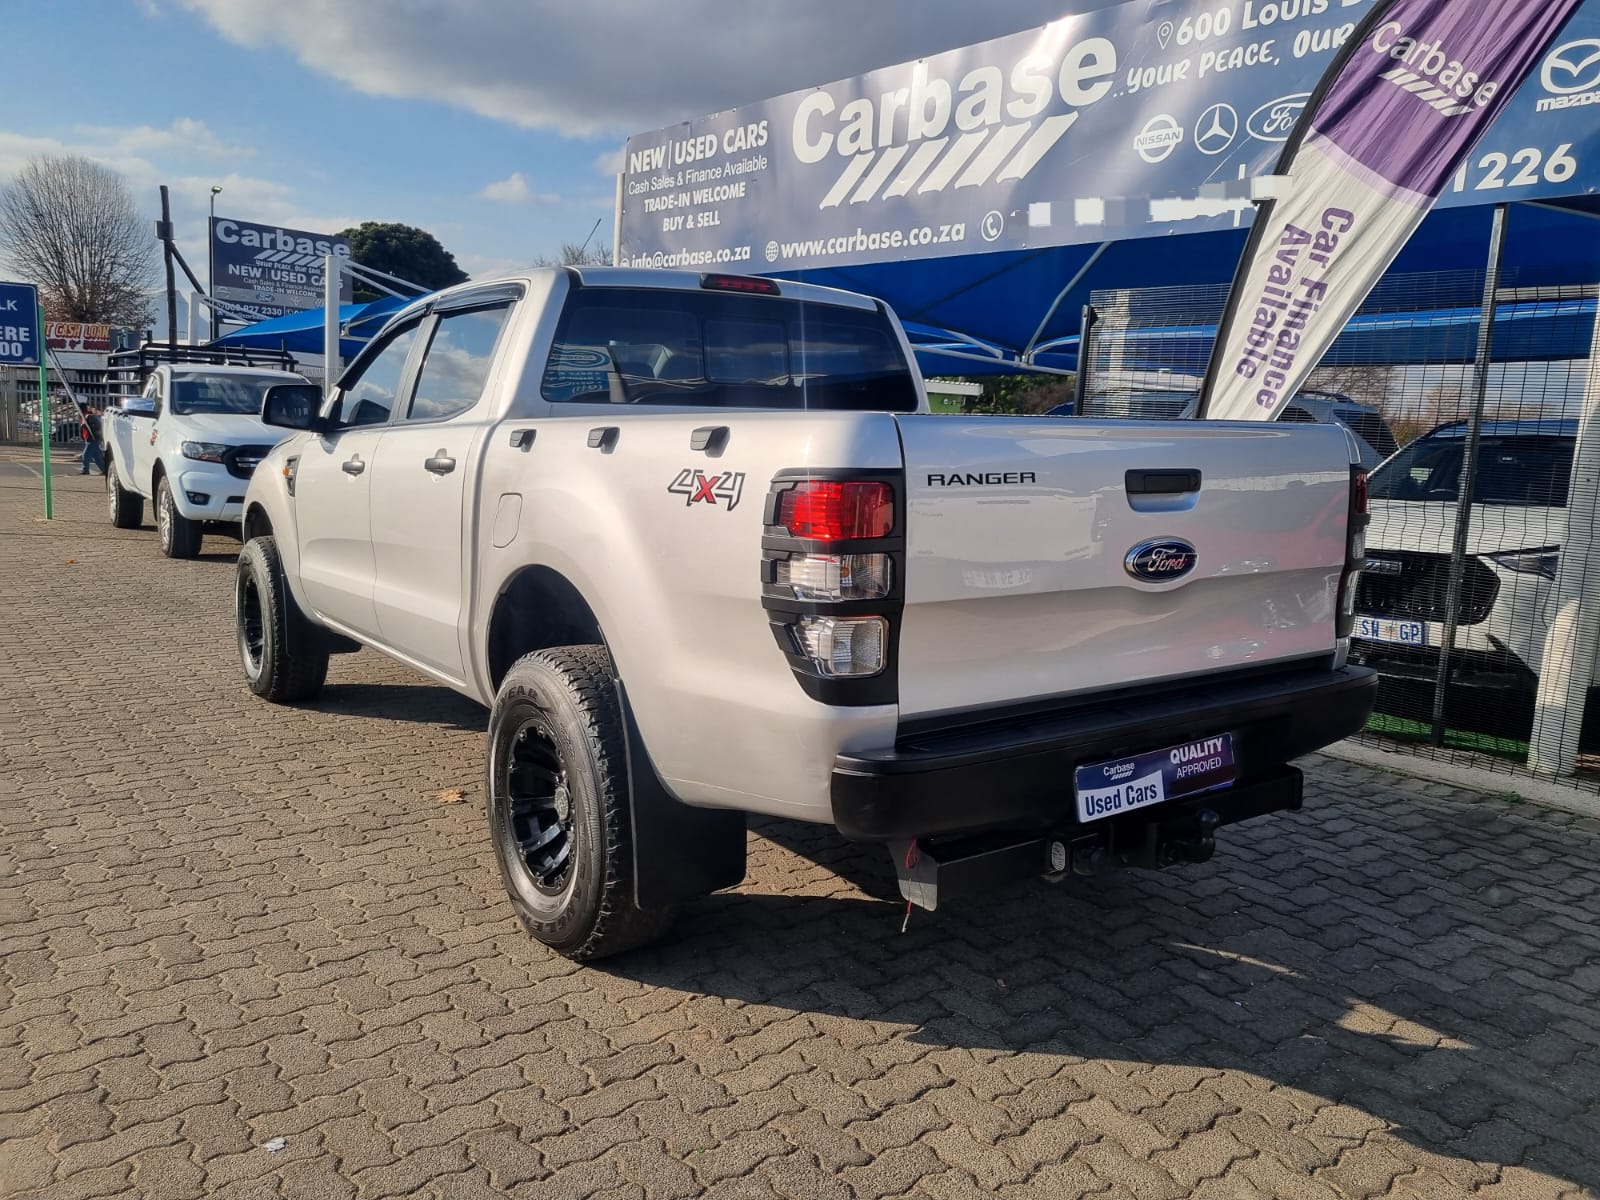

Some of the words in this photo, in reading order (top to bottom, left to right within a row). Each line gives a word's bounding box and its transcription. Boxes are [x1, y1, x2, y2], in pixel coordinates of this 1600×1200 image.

[1176, 7, 1231, 46] 600
[1293, 22, 1355, 58] OUR
[1372, 21, 1498, 107] Carbase
[792, 37, 1117, 164] Carbase
[630, 145, 666, 174] NEW
[675, 134, 718, 165] USED
[723, 120, 768, 154] CARS
[1136, 130, 1182, 146] NISSAN
[629, 178, 650, 195] Cash
[651, 175, 675, 191] Sales
[677, 171, 684, 186] &
[686, 168, 722, 185] Finance
[723, 155, 768, 177] Available
[644, 192, 692, 213] TRADE-IN
[693, 182, 746, 204] WELCOME
[663, 216, 684, 232] BUY
[686, 214, 695, 229] &
[697, 210, 721, 227] SELL
[216, 220, 351, 260] Carbase
[781, 222, 965, 259] www.carbase.co.za
[1308, 207, 1355, 269] Car
[631, 246, 751, 269] info@carbase.co.za
[228, 264, 262, 278] NEW
[270, 269, 307, 283] USED
[311, 275, 344, 289] CAS
[243, 277, 259, 285] Cash
[253, 285, 285, 295] TRADE-IN
[286, 288, 317, 298] WELCOME
[1236, 223, 1313, 380] Available
[261, 306, 282, 316] 2330
[55, 323, 80, 338] CASH
[1256, 277, 1329, 409] Finance
[927, 471, 1036, 486] RANGER
[1147, 548, 1188, 572] Ford
[1400, 623, 1420, 641] GP
[1170, 737, 1224, 765] QUALITY
[1103, 762, 1135, 776] Carbase
[1176, 757, 1222, 779] APPROVED
[1085, 788, 1122, 816] Used
[1126, 783, 1158, 806] Cars
